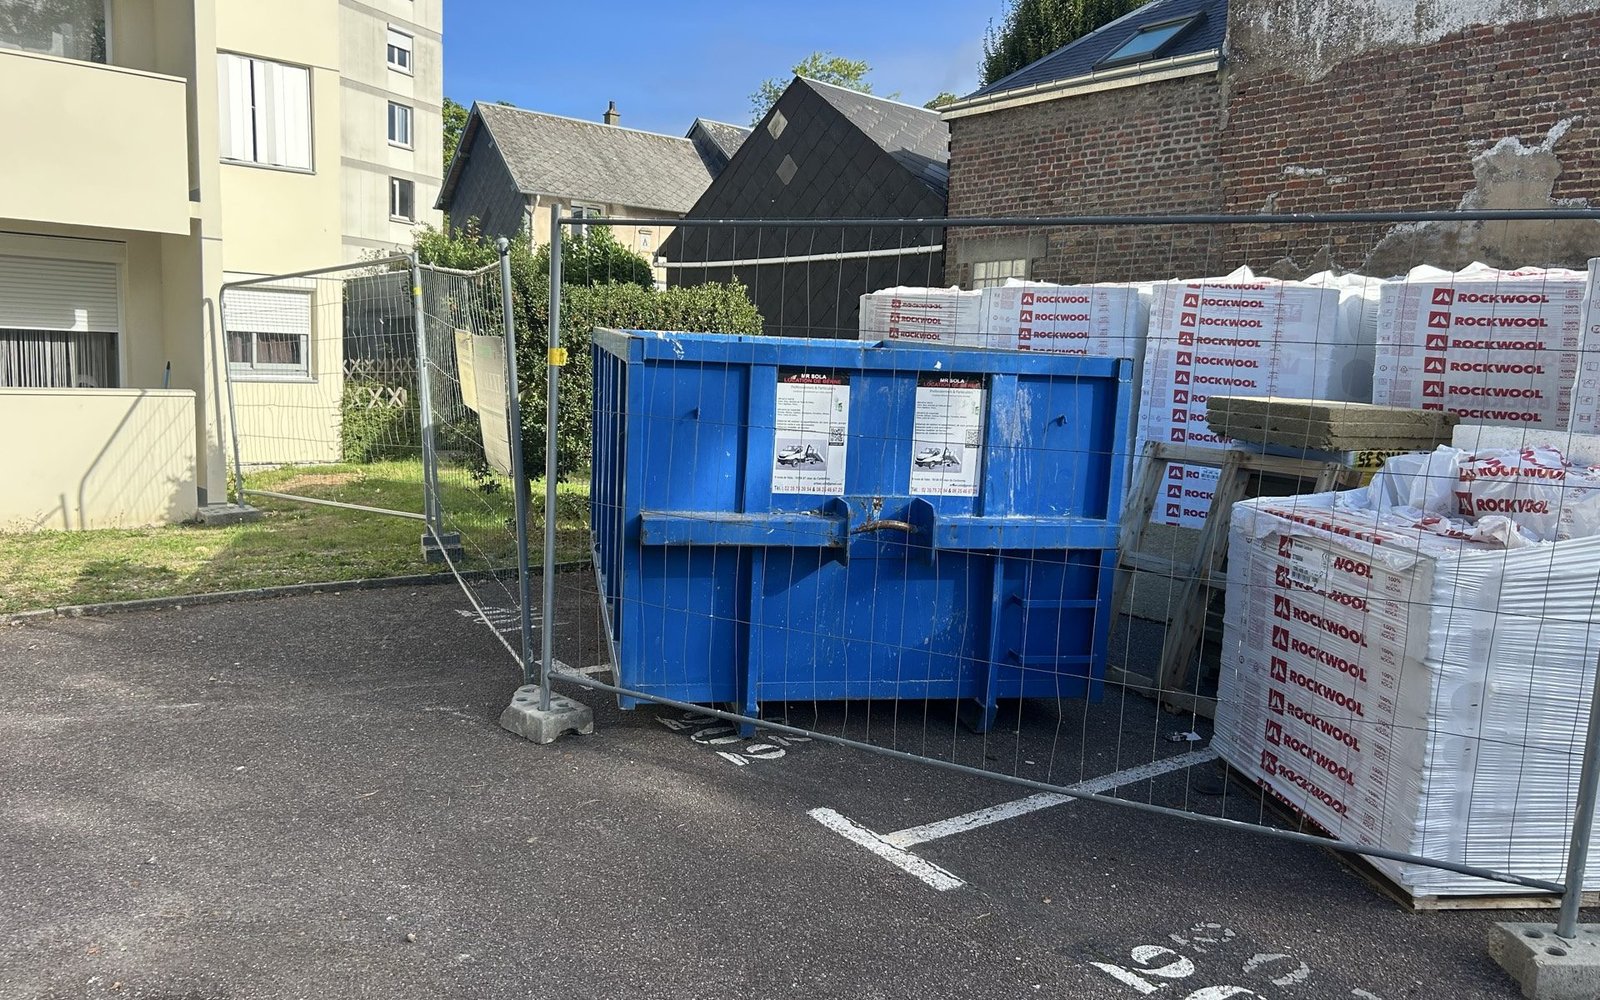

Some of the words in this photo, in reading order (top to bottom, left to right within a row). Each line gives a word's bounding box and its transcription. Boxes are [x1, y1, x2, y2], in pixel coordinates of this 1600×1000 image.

[1202, 298, 1264, 308] ROCKWOOL
[1458, 294, 1549, 304] ROCKWOOL
[901, 315, 942, 325] ROCKWOOL
[1200, 317, 1263, 328] ROCKWOOL
[1455, 317, 1548, 327] ROCKWOOL
[901, 331, 941, 341] ROCKWOOL
[1033, 331, 1090, 340] ROCKWOOL
[1197, 336, 1261, 348] ROCKWOOL
[1453, 339, 1547, 350] ROCKWOOL
[1195, 356, 1259, 369] ROCKWOOL
[1451, 362, 1545, 374] ROCKWOOL
[1193, 375, 1257, 388] ROCKWOOL
[1449, 385, 1544, 399] ROCKWOOL
[1387, 575, 1401, 584] 100%
[1292, 606, 1368, 648] ROCKWOOL
[1291, 638, 1367, 682] ROCKWOOL
[1289, 669, 1364, 717] ROCKWOOL
[1287, 701, 1361, 753] ROCKWOOL
[1283, 733, 1355, 787] ROCKWOOL
